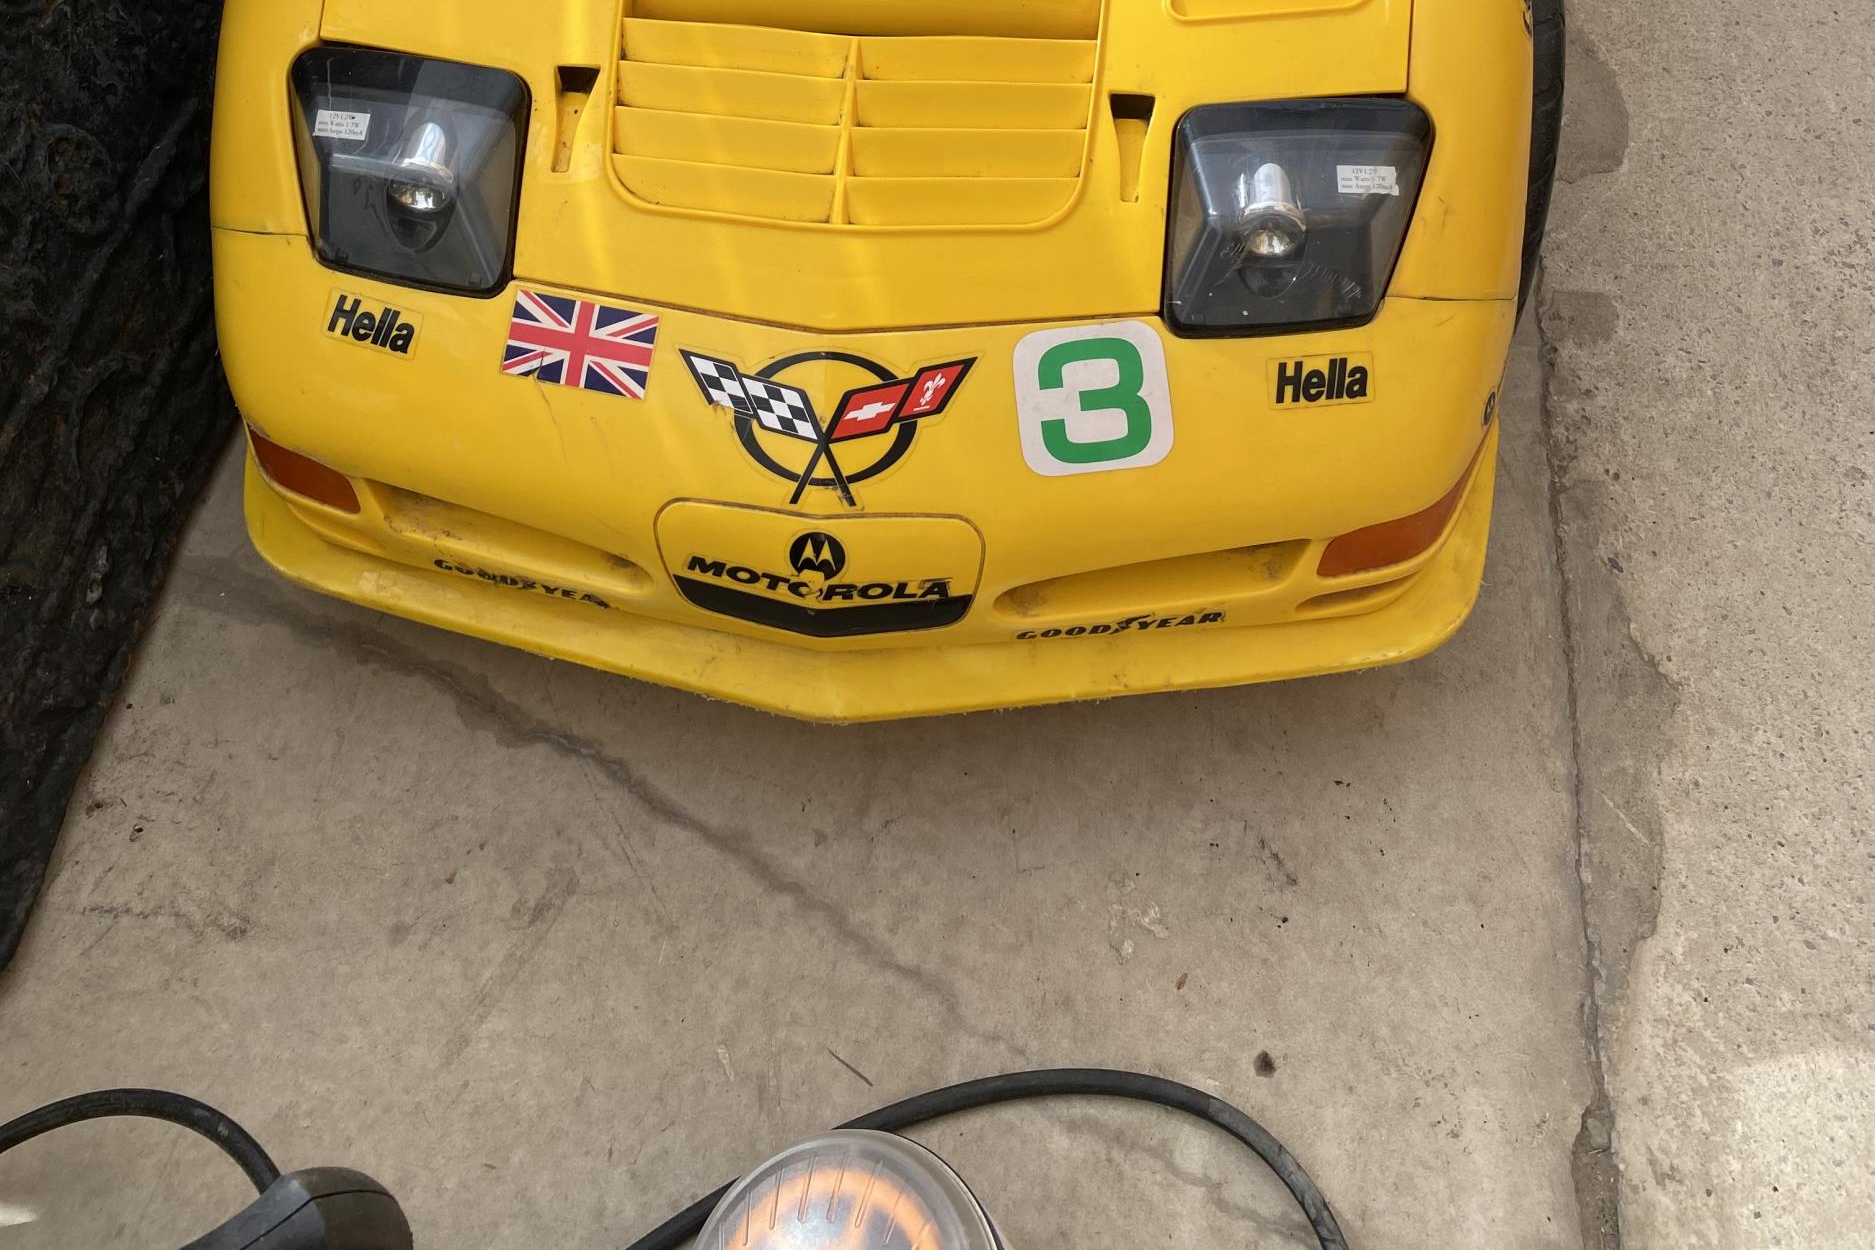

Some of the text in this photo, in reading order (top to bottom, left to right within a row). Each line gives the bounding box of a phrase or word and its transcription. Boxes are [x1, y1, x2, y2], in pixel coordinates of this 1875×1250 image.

[328, 294, 415, 355] Hella
[1037, 337, 1152, 464] 3
[1275, 357, 1369, 405] Hella
[687, 555, 952, 601] MOTOROLA
[1016, 610, 1224, 640] GOODYEAR
